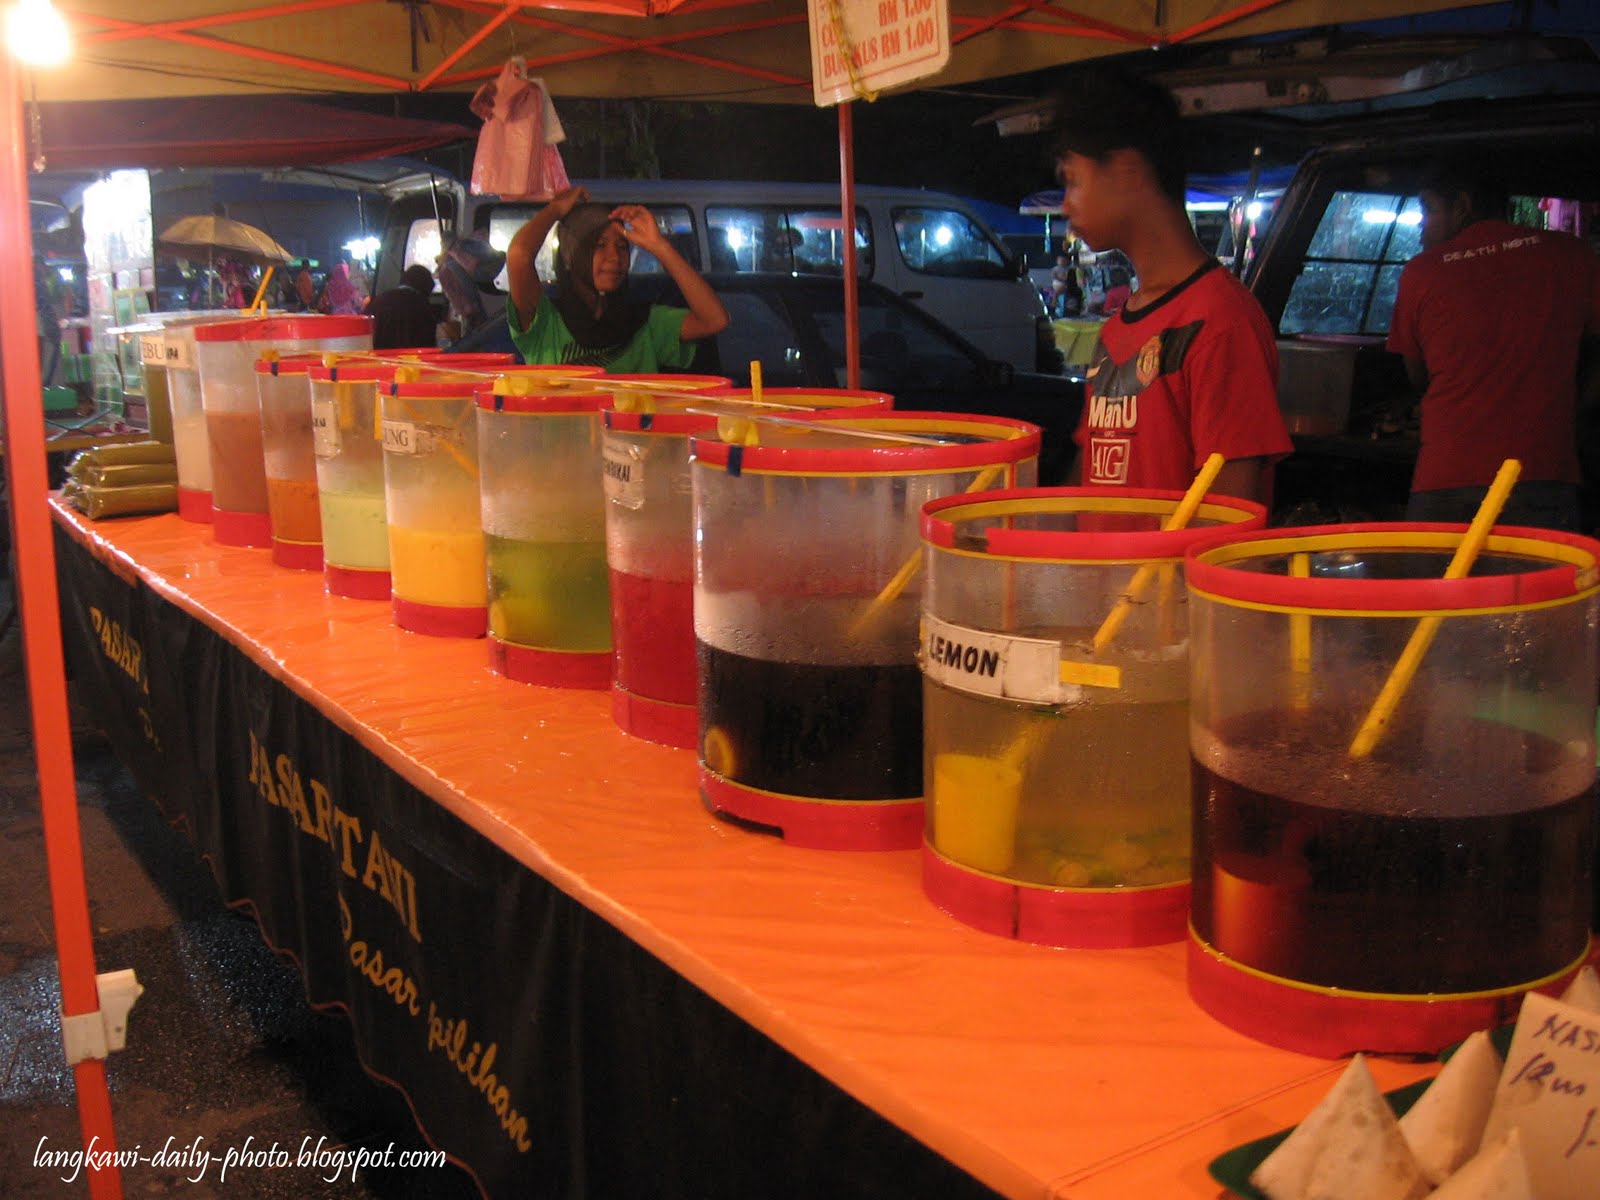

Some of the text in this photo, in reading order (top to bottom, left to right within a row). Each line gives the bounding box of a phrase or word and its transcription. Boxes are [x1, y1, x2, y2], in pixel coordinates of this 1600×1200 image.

[879, 1, 898, 27] RM
[881, 29, 900, 58] RM
[906, 18, 934, 51] 1.00
[1442, 235, 1541, 263] DEATH NOTE
[1088, 395, 1137, 429] ManU
[1092, 445, 1123, 478] AIG
[929, 633, 1000, 678] LEMON
